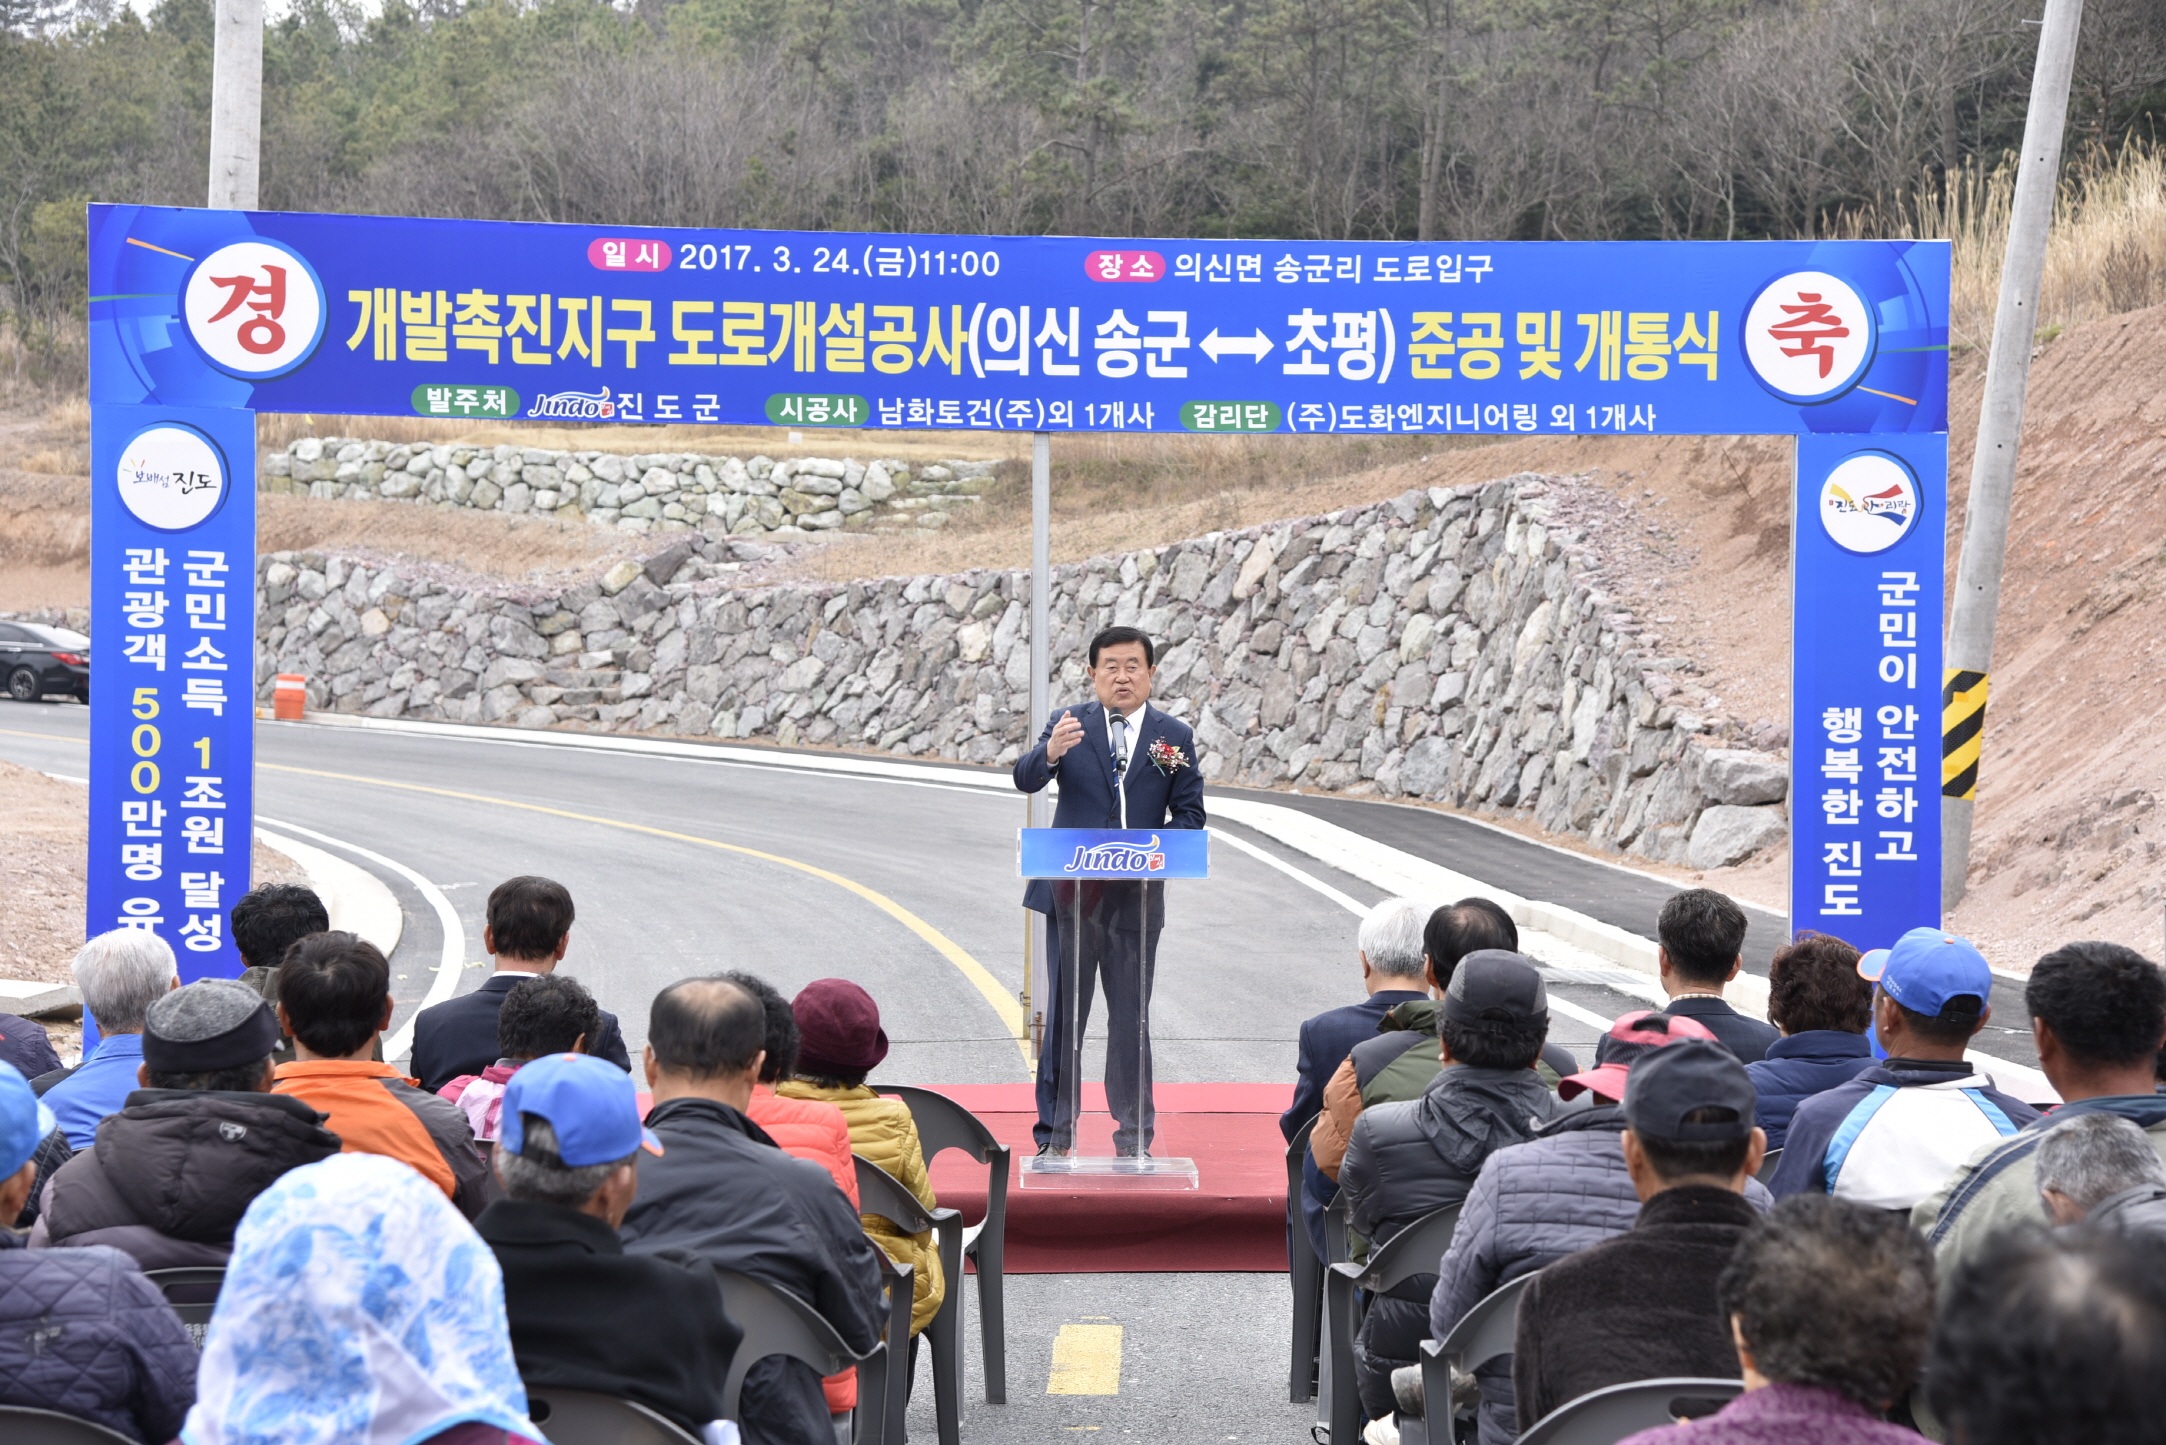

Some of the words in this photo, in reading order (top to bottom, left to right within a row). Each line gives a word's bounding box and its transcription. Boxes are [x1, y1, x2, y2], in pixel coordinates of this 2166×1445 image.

[680, 244, 760, 272] 2017.
[774, 246, 800, 273] 3.
[1175, 253, 1261, 282] 의신면
[1274, 254, 1361, 283] 송군리
[1374, 254, 1493, 283] 도로입구
[208, 265, 286, 354] 경
[347, 288, 655, 368] 개발촉진지구
[1095, 309, 1190, 378] 송군
[1283, 308, 1395, 383] 초평)
[1409, 312, 1504, 379] 준공
[1517, 311, 1561, 380] 및
[1574, 311, 1718, 380] 개통식
[1768, 292, 1849, 378] 축
[427, 388, 506, 415] 발주처
[528, 394, 600, 418] Jindo
[780, 397, 857, 422] 시공사
[1085, 401, 1154, 429] 1개사
[1194, 404, 1268, 428] 감리단
[1287, 404, 1538, 432] (주)도화엔지니어링
[1550, 404, 1575, 431] 외
[1587, 404, 1656, 431] 1개사
[172, 470, 218, 495] 진도
[123, 548, 170, 671] 관광객
[182, 551, 229, 716] 군민소득
[1878, 572, 1920, 688] 군민이
[122, 688, 167, 880] 500만명
[181, 737, 226, 854] 1조원
[1821, 708, 1863, 824] 행복한
[1875, 705, 1919, 860] 안전하고
[1064, 845, 1149, 872] Jindo
[1820, 841, 1862, 915] 진도
[178, 871, 224, 951] 달성
